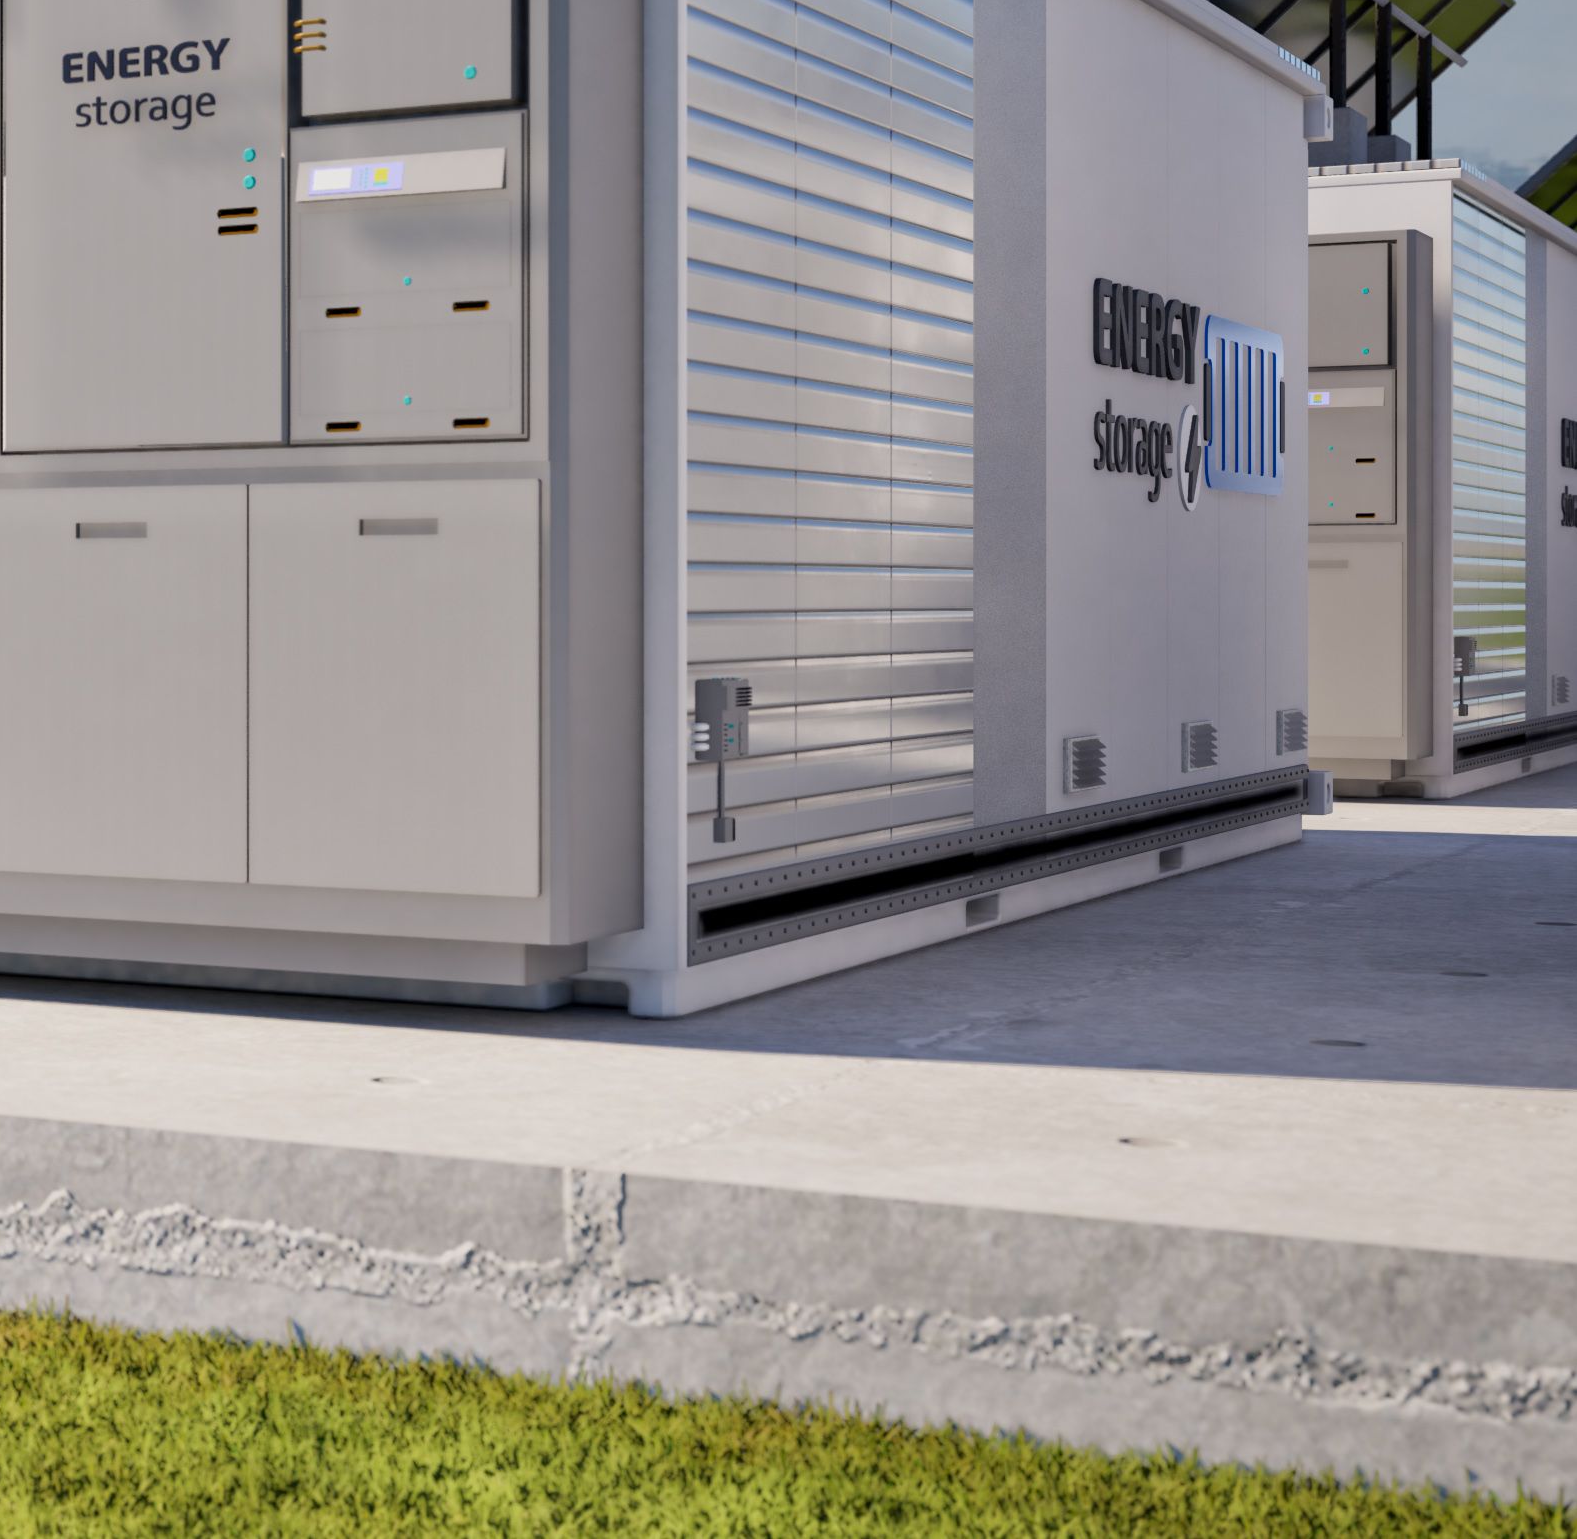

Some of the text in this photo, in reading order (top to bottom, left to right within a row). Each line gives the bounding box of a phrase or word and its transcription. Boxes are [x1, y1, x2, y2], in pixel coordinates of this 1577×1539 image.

[62, 37, 231, 84] ENERGY
[75, 91, 217, 131] storage
[1093, 278, 1200, 385] ENERGY
[1093, 399, 1173, 502] storage
